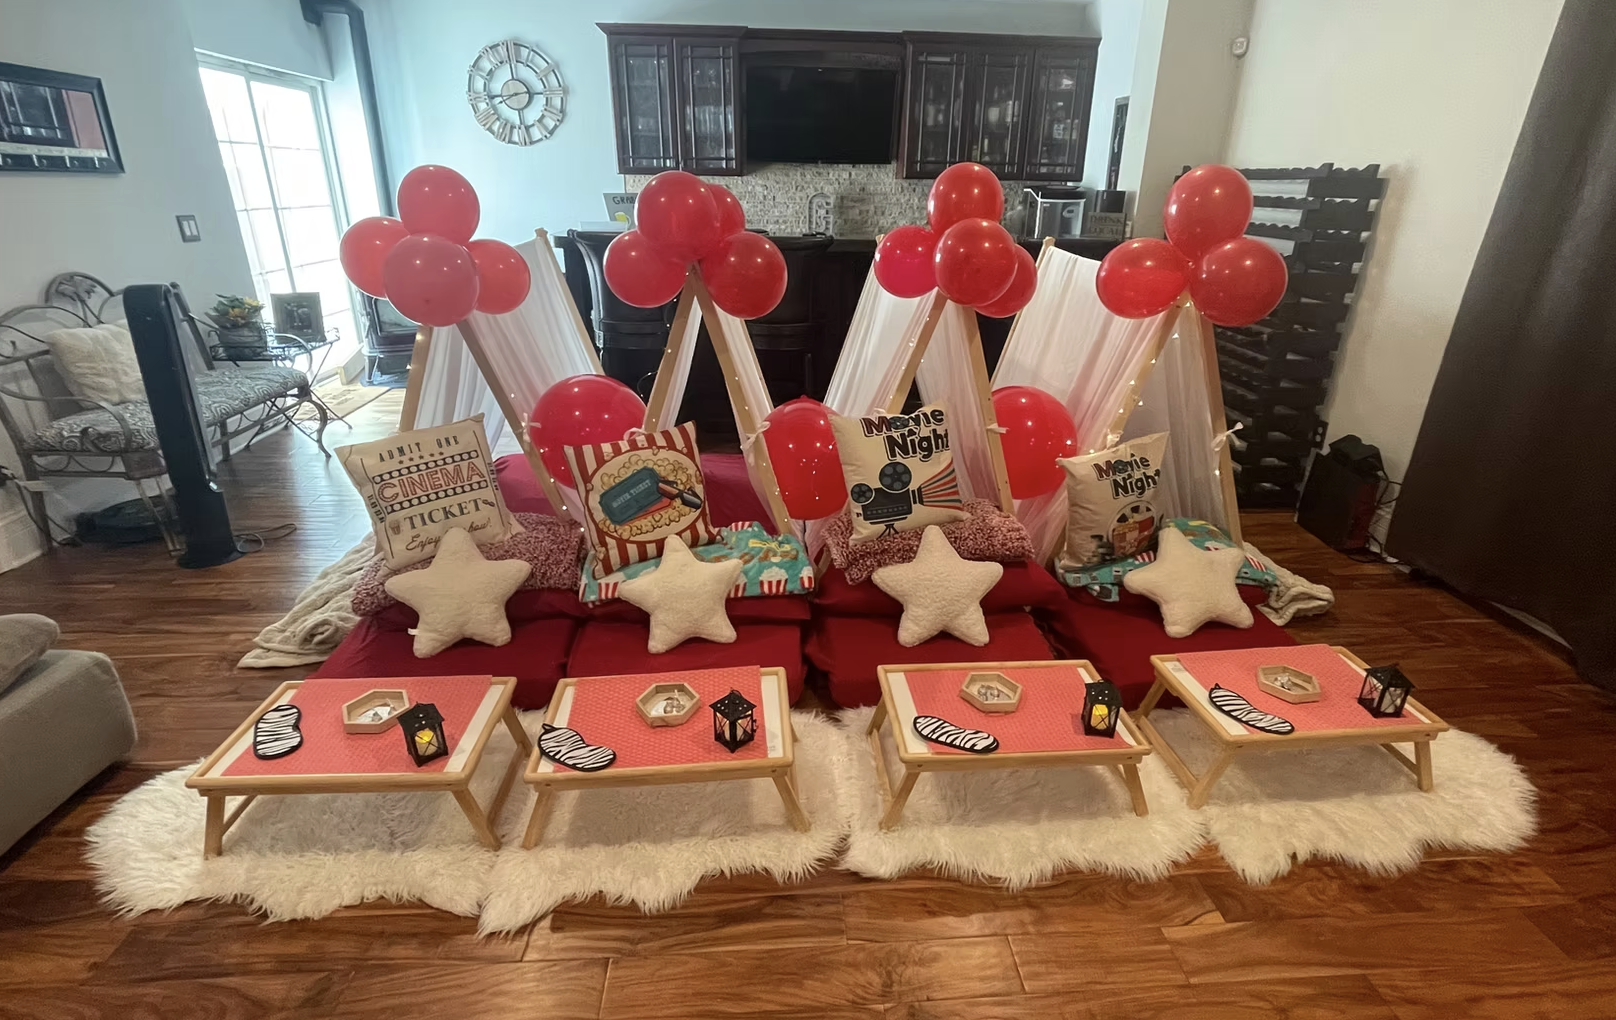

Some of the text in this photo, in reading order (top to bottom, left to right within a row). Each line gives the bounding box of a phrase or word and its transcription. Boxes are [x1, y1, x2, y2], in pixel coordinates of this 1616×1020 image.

[860, 408, 945, 438] Movie
[378, 435, 460, 463] ADMIT ONE
[377, 461, 487, 503] CINEMA
[1091, 452, 1151, 481] Movie
[404, 497, 482, 531] TICKET
[405, 517, 493, 553] Enjoy how!
